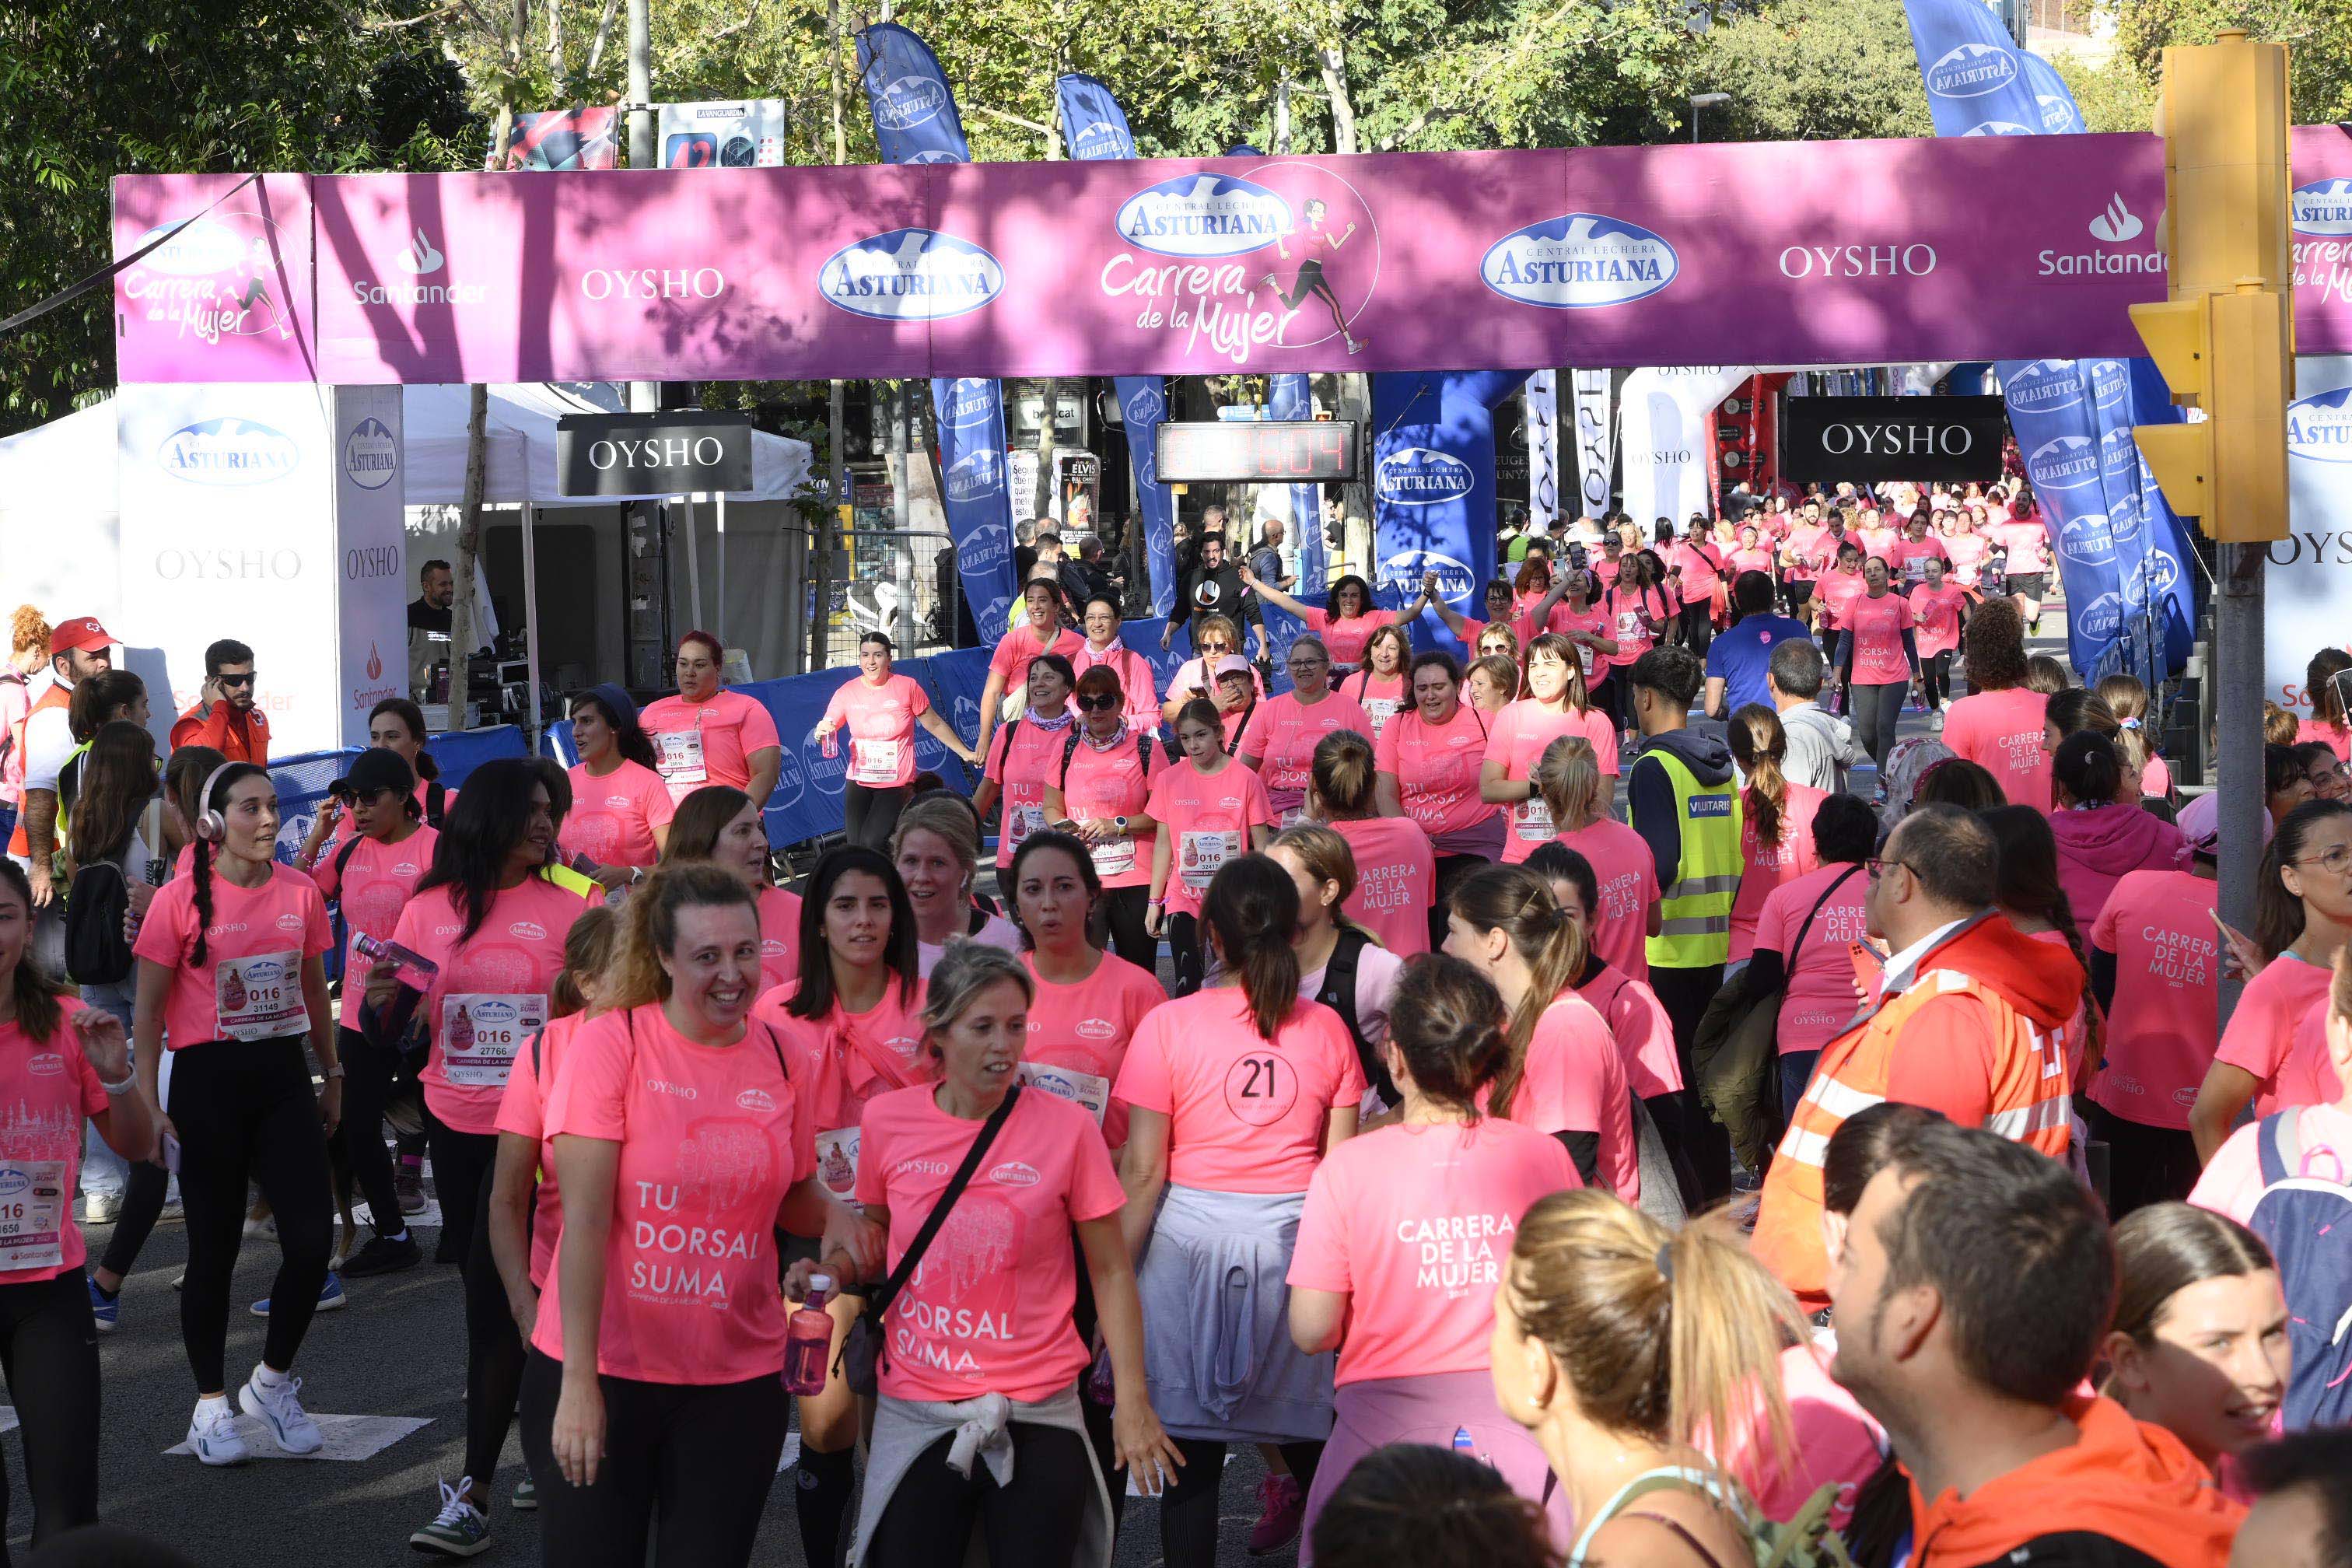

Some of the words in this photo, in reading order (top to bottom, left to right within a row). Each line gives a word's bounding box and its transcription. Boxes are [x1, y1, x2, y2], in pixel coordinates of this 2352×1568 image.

[1129, 205, 1279, 236] ASTURIANA
[1525, 247, 1587, 257] CENTRAL
[1593, 245, 1657, 255] LECHERA
[1778, 243, 1937, 278] OYSHO
[2292, 241, 2352, 264] arrer
[1101, 253, 1246, 297] Carrera
[1495, 250, 1664, 285] ASTURIANA
[124, 269, 218, 299] Carrera
[580, 268, 725, 300] OYSHO
[833, 264, 991, 297] ASTURIANA
[352, 280, 487, 306] Santander
[177, 297, 250, 345] Mujer
[1136, 299, 1164, 330] de
[1169, 296, 1188, 329] la
[1184, 290, 1300, 365] Mujer
[1821, 423, 1972, 457] OYSHO
[348, 445, 394, 472] ASTURIANA
[588, 436, 724, 470] OYSHO
[1632, 449, 1692, 465] OYSHO
[1072, 464, 1096, 474] ELVIS
[1379, 471, 1467, 492] ASTURIANA
[156, 547, 302, 580] OYSHO
[347, 545, 399, 580] OYSHO
[1859, 647, 1892, 656] DORSAL
[1860, 658, 1885, 667] SUMA
[667, 752, 684, 761] 016
[2010, 747, 2023, 758] DE
[2025, 745, 2039, 757] LA
[1276, 757, 1293, 768] TU
[2009, 754, 2041, 770] MUJER
[1281, 770, 1307, 782] DOR
[1012, 782, 1029, 796] TU
[1406, 782, 1424, 793] TU
[1070, 807, 1087, 819] TU
[1403, 806, 1445, 820] SUMA
[1199, 853, 1221, 862] 016
[1754, 852, 1794, 867] MUJER
[1358, 863, 1418, 884] ARRERA
[1365, 881, 1384, 896] DE
[1388, 877, 1407, 892] LA
[1597, 870, 1642, 899] CARRERA
[1363, 891, 1411, 910] MUJER
[1607, 894, 1619, 906] DE
[1622, 887, 1634, 898] LA
[208, 922, 247, 936] OYSHO
[436, 925, 468, 936] OYSH
[512, 926, 544, 937] ASTURIANA
[1828, 918, 1849, 929] DE
[1856, 919, 1867, 929] L
[2154, 944, 2177, 963] DE
[2184, 952, 2205, 970] LA
[247, 969, 280, 979] ASTURIANA
[2148, 960, 2206, 985] MUJER
[250, 987, 281, 1002] 016
[254, 1003, 278, 1013] 31149
[476, 1010, 513, 1018] ASTURIANA
[1794, 1016, 1836, 1025] OYSHO
[477, 1030, 512, 1043] 016
[480, 1047, 507, 1055] 27766
[1241, 1059, 1275, 1098] 21
[646, 1078, 698, 1100] OYSHO
[897, 1160, 949, 1176] OYSHO
[993, 1170, 1037, 1183] ASTURIANA
[635, 1180, 679, 1212] TU
[2, 1203, 24, 1219] 16
[1397, 1213, 1515, 1242] CARRERA
[635, 1220, 758, 1260] DORSAL
[19, 1250, 54, 1260] Santander
[1421, 1241, 1454, 1265] DE
[1462, 1239, 1494, 1262] LA
[630, 1260, 728, 1299] SUMA
[1416, 1261, 1500, 1288] MUJER
[898, 1290, 1014, 1340] DORSAL
